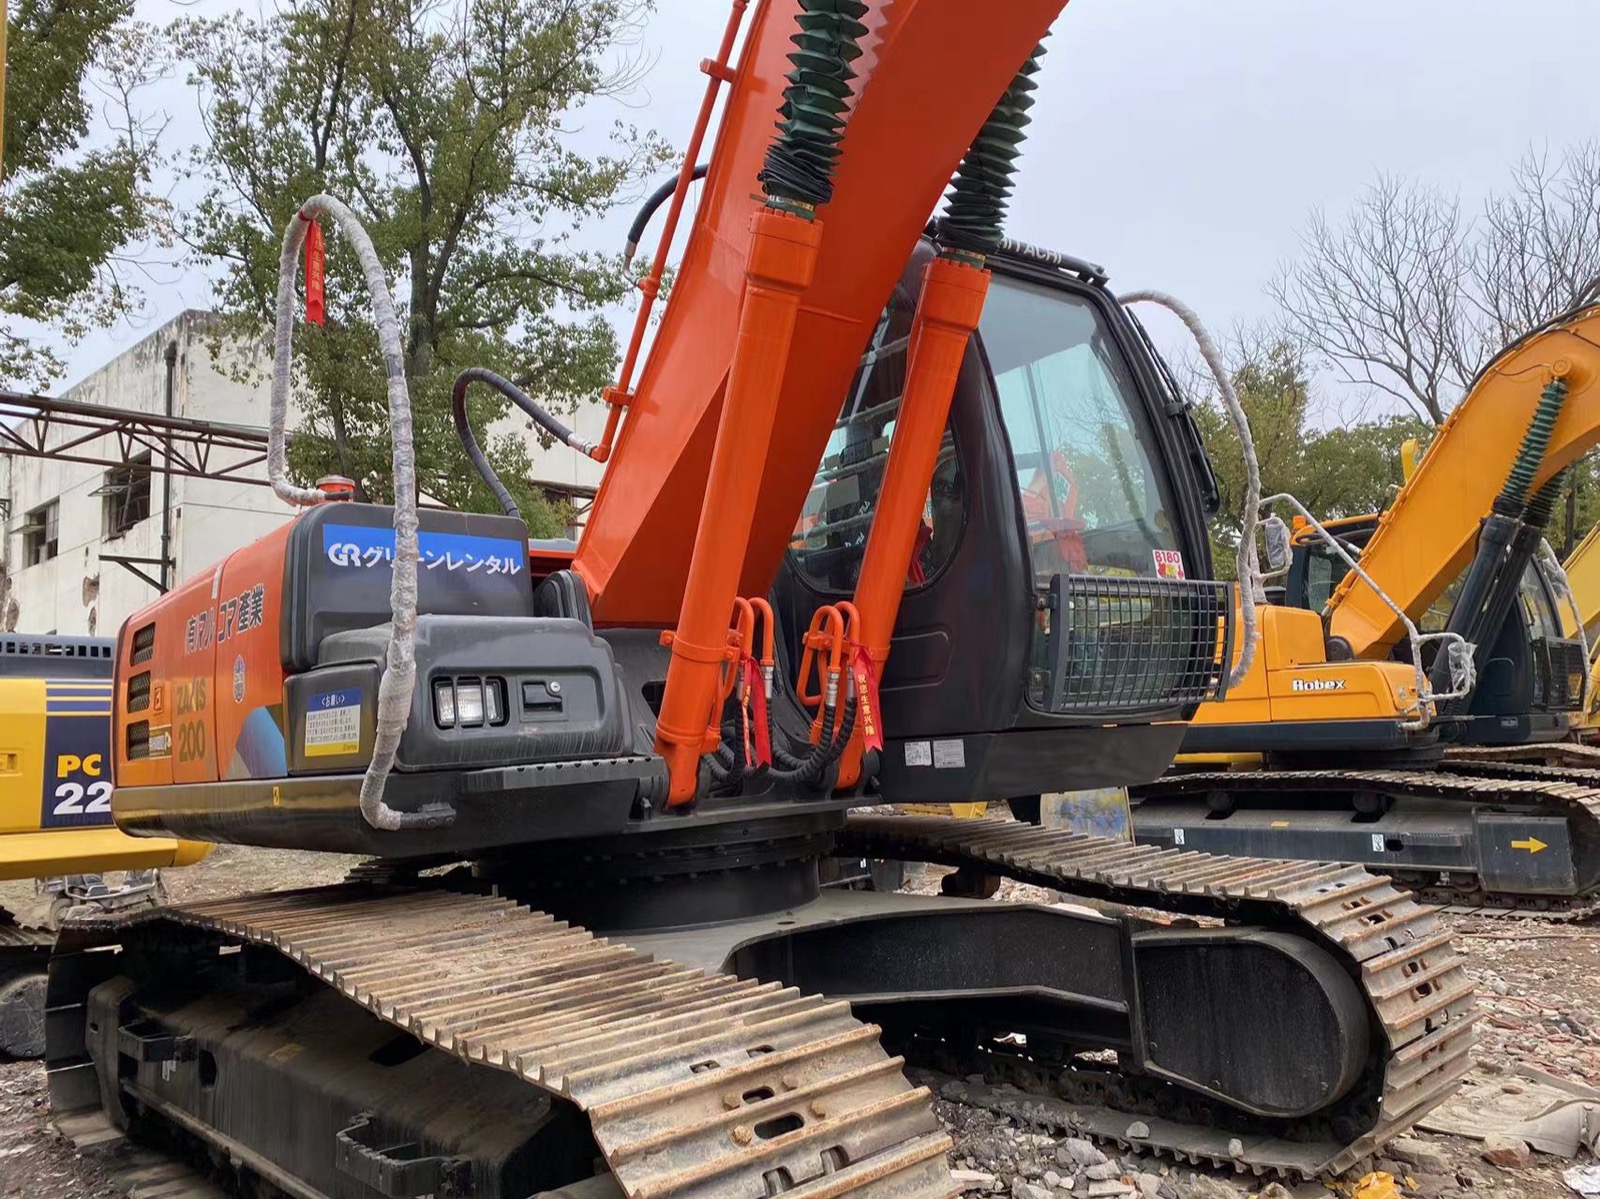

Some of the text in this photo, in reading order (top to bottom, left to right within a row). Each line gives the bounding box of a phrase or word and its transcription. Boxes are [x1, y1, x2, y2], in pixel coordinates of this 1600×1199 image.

[1155, 551, 1180, 563] B180
[1292, 679, 1347, 691] Robex
[179, 719, 206, 762] 200
[57, 754, 101, 778] PC
[53, 781, 114, 815] 22
